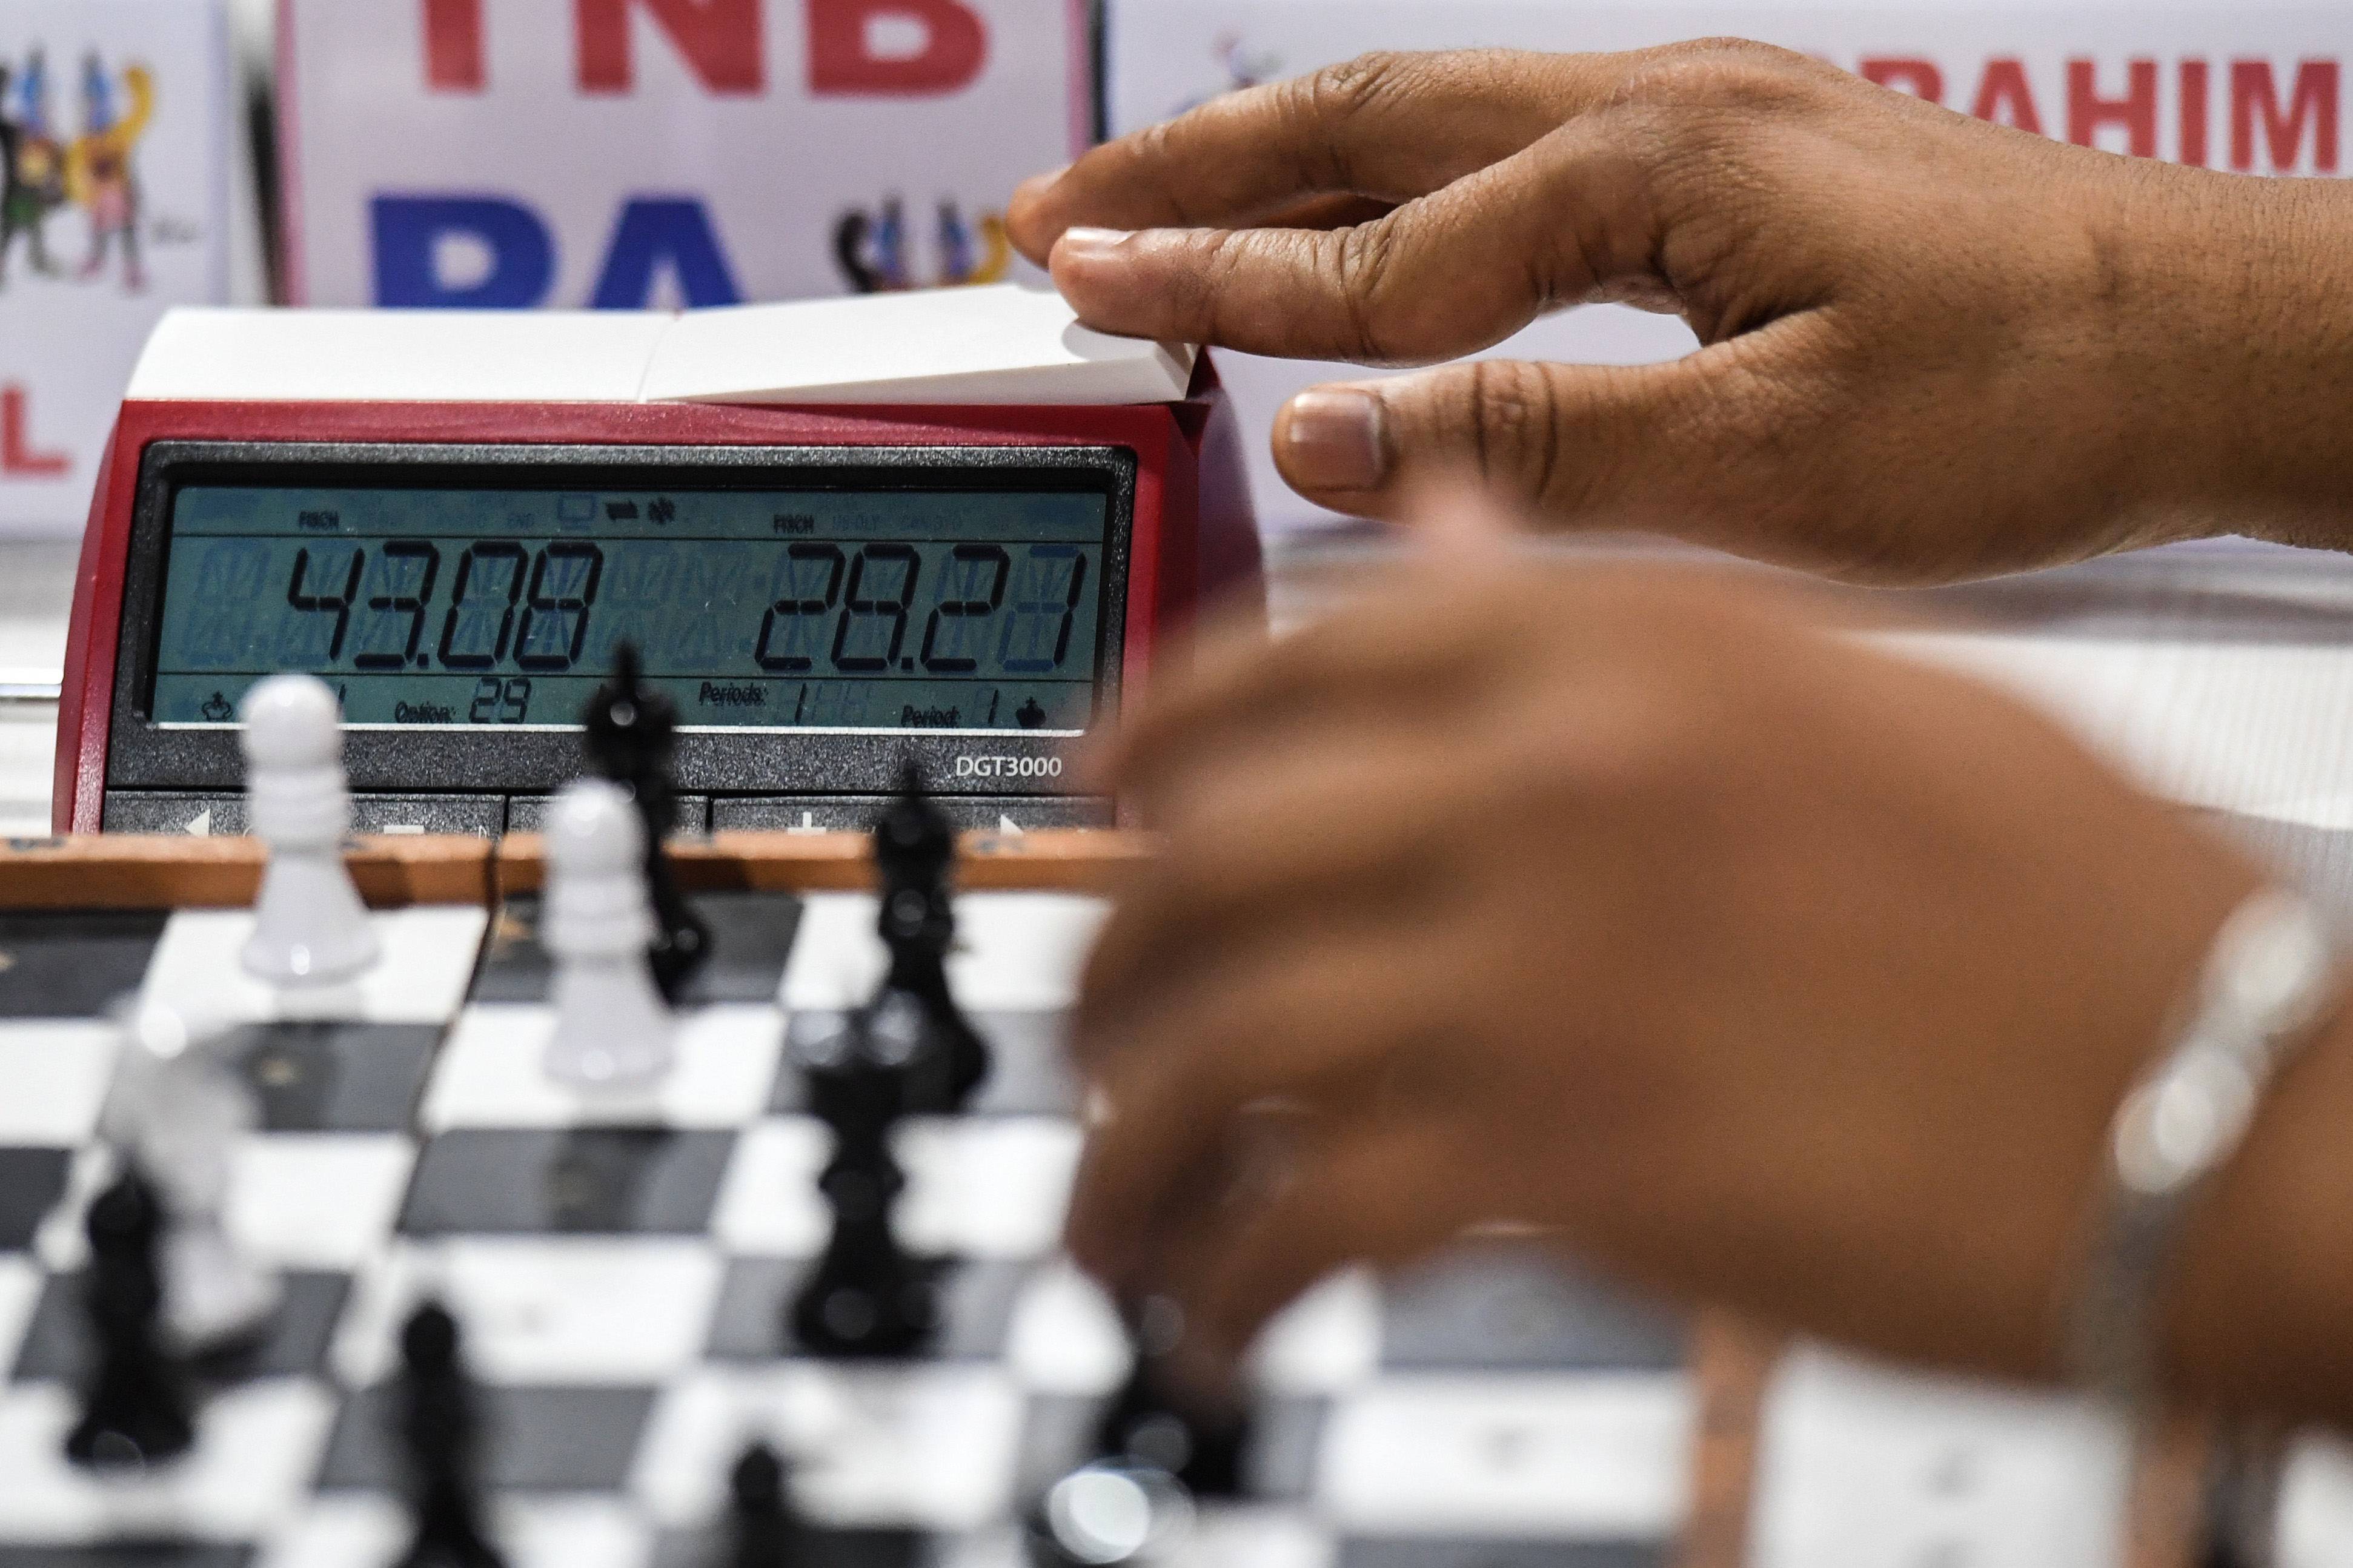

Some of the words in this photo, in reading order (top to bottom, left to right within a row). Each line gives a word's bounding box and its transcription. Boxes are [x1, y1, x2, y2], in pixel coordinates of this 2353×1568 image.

[1805, 56, 2341, 173] AHIM
[287, 541, 603, 671] 43.08
[754, 543, 1087, 672] 28.21
[468, 676, 531, 725] 29
[955, 756, 1062, 777] DGT3000
